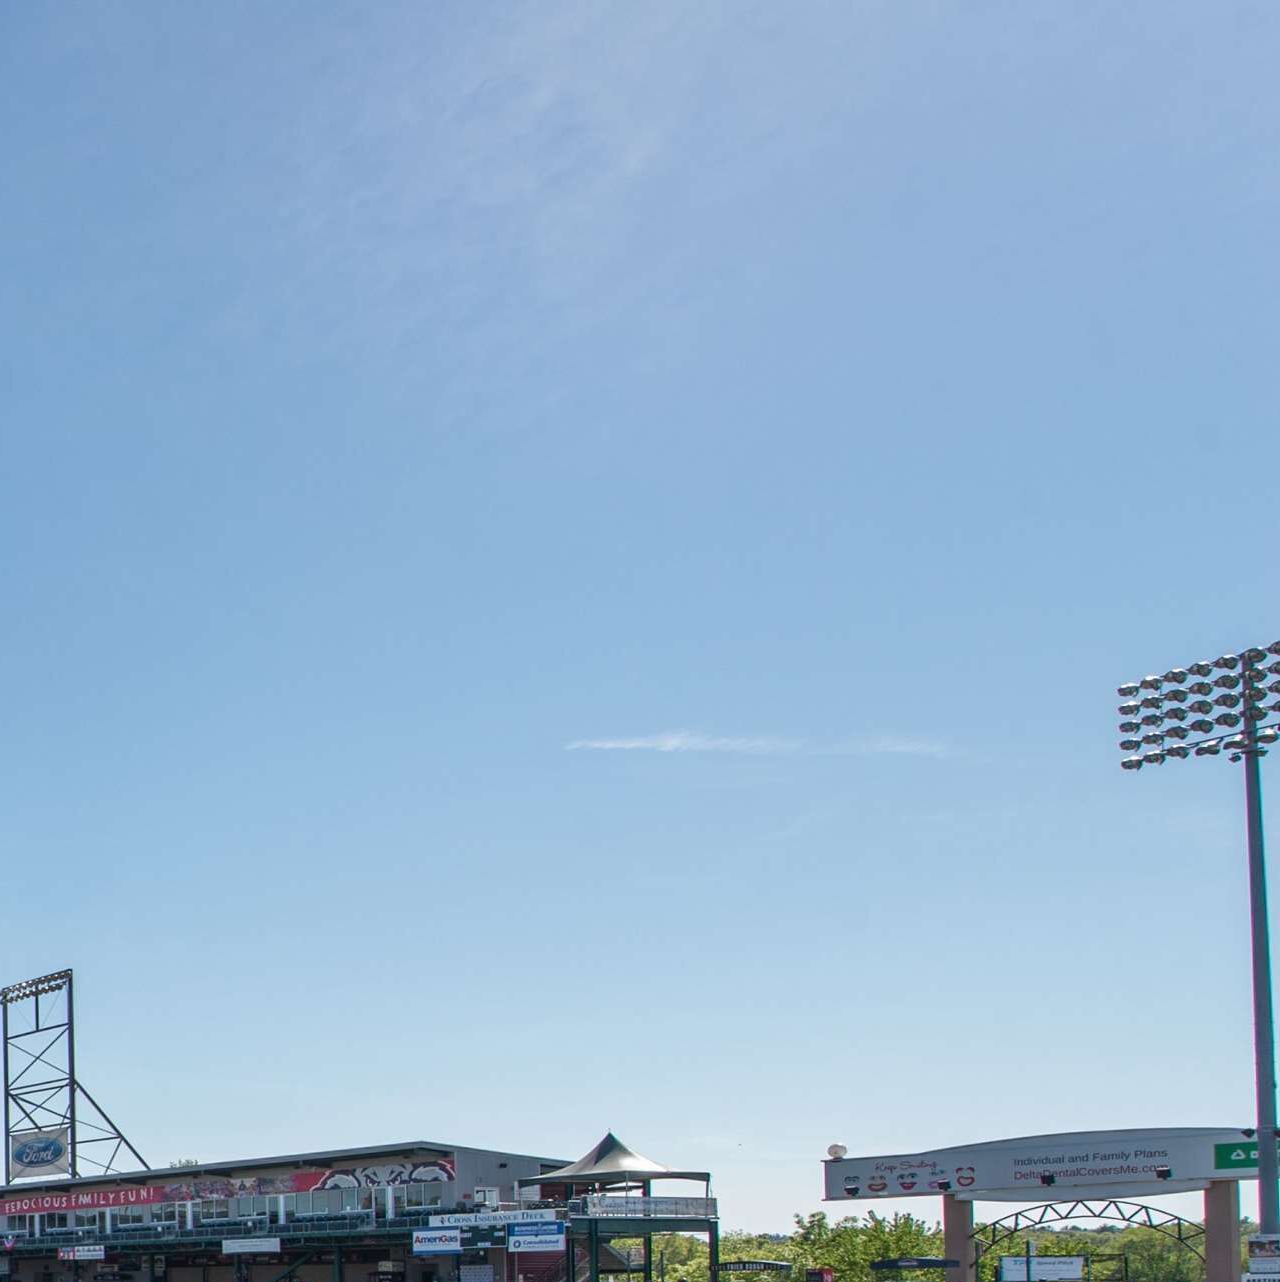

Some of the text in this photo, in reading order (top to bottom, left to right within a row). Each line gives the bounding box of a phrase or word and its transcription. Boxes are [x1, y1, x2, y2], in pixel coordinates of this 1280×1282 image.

[23, 1146, 54, 1162] Ford
[1014, 1149, 1169, 1167] Individual and Family Plans
[5, 1187, 154, 1213] FEROCIOUS FAMILY FUN!
[474, 1214, 517, 1223] INSURANCE
[414, 1234, 459, 1245] AmeriGas
